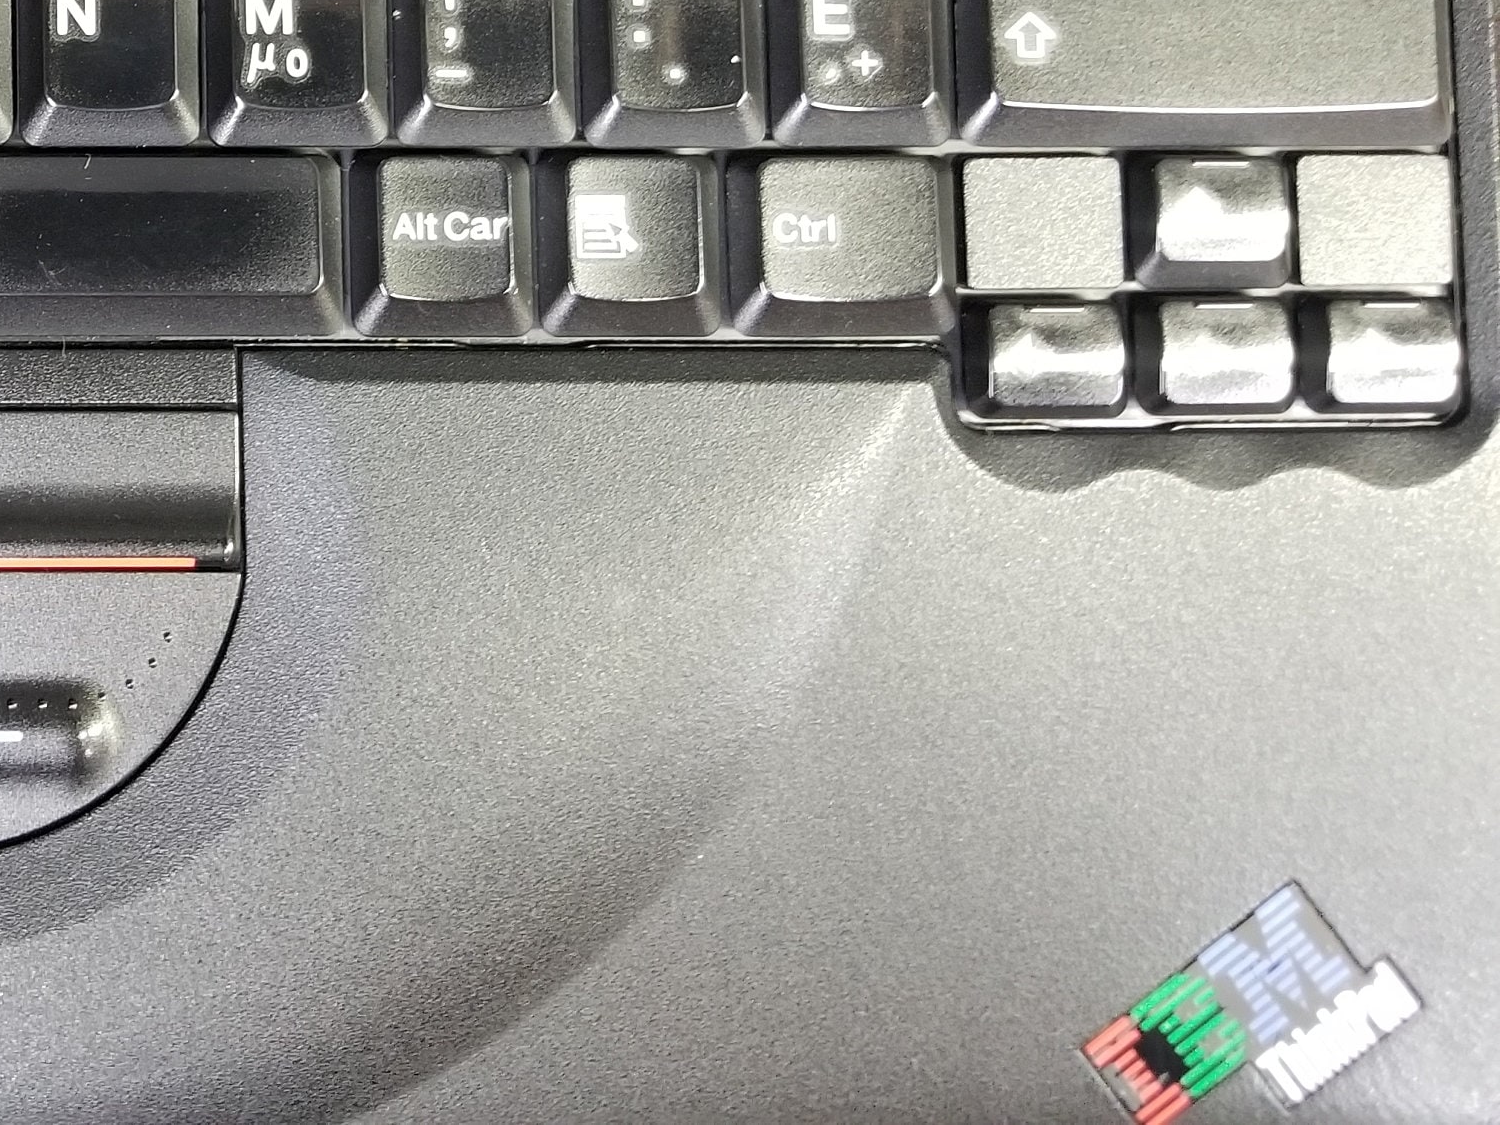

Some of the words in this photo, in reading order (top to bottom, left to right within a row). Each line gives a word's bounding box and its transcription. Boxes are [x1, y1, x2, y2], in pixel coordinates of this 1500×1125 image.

[285, 48, 309, 78] 0
[392, 211, 439, 241] Alt
[443, 210, 509, 242] Car
[772, 213, 836, 243] Ctrl
